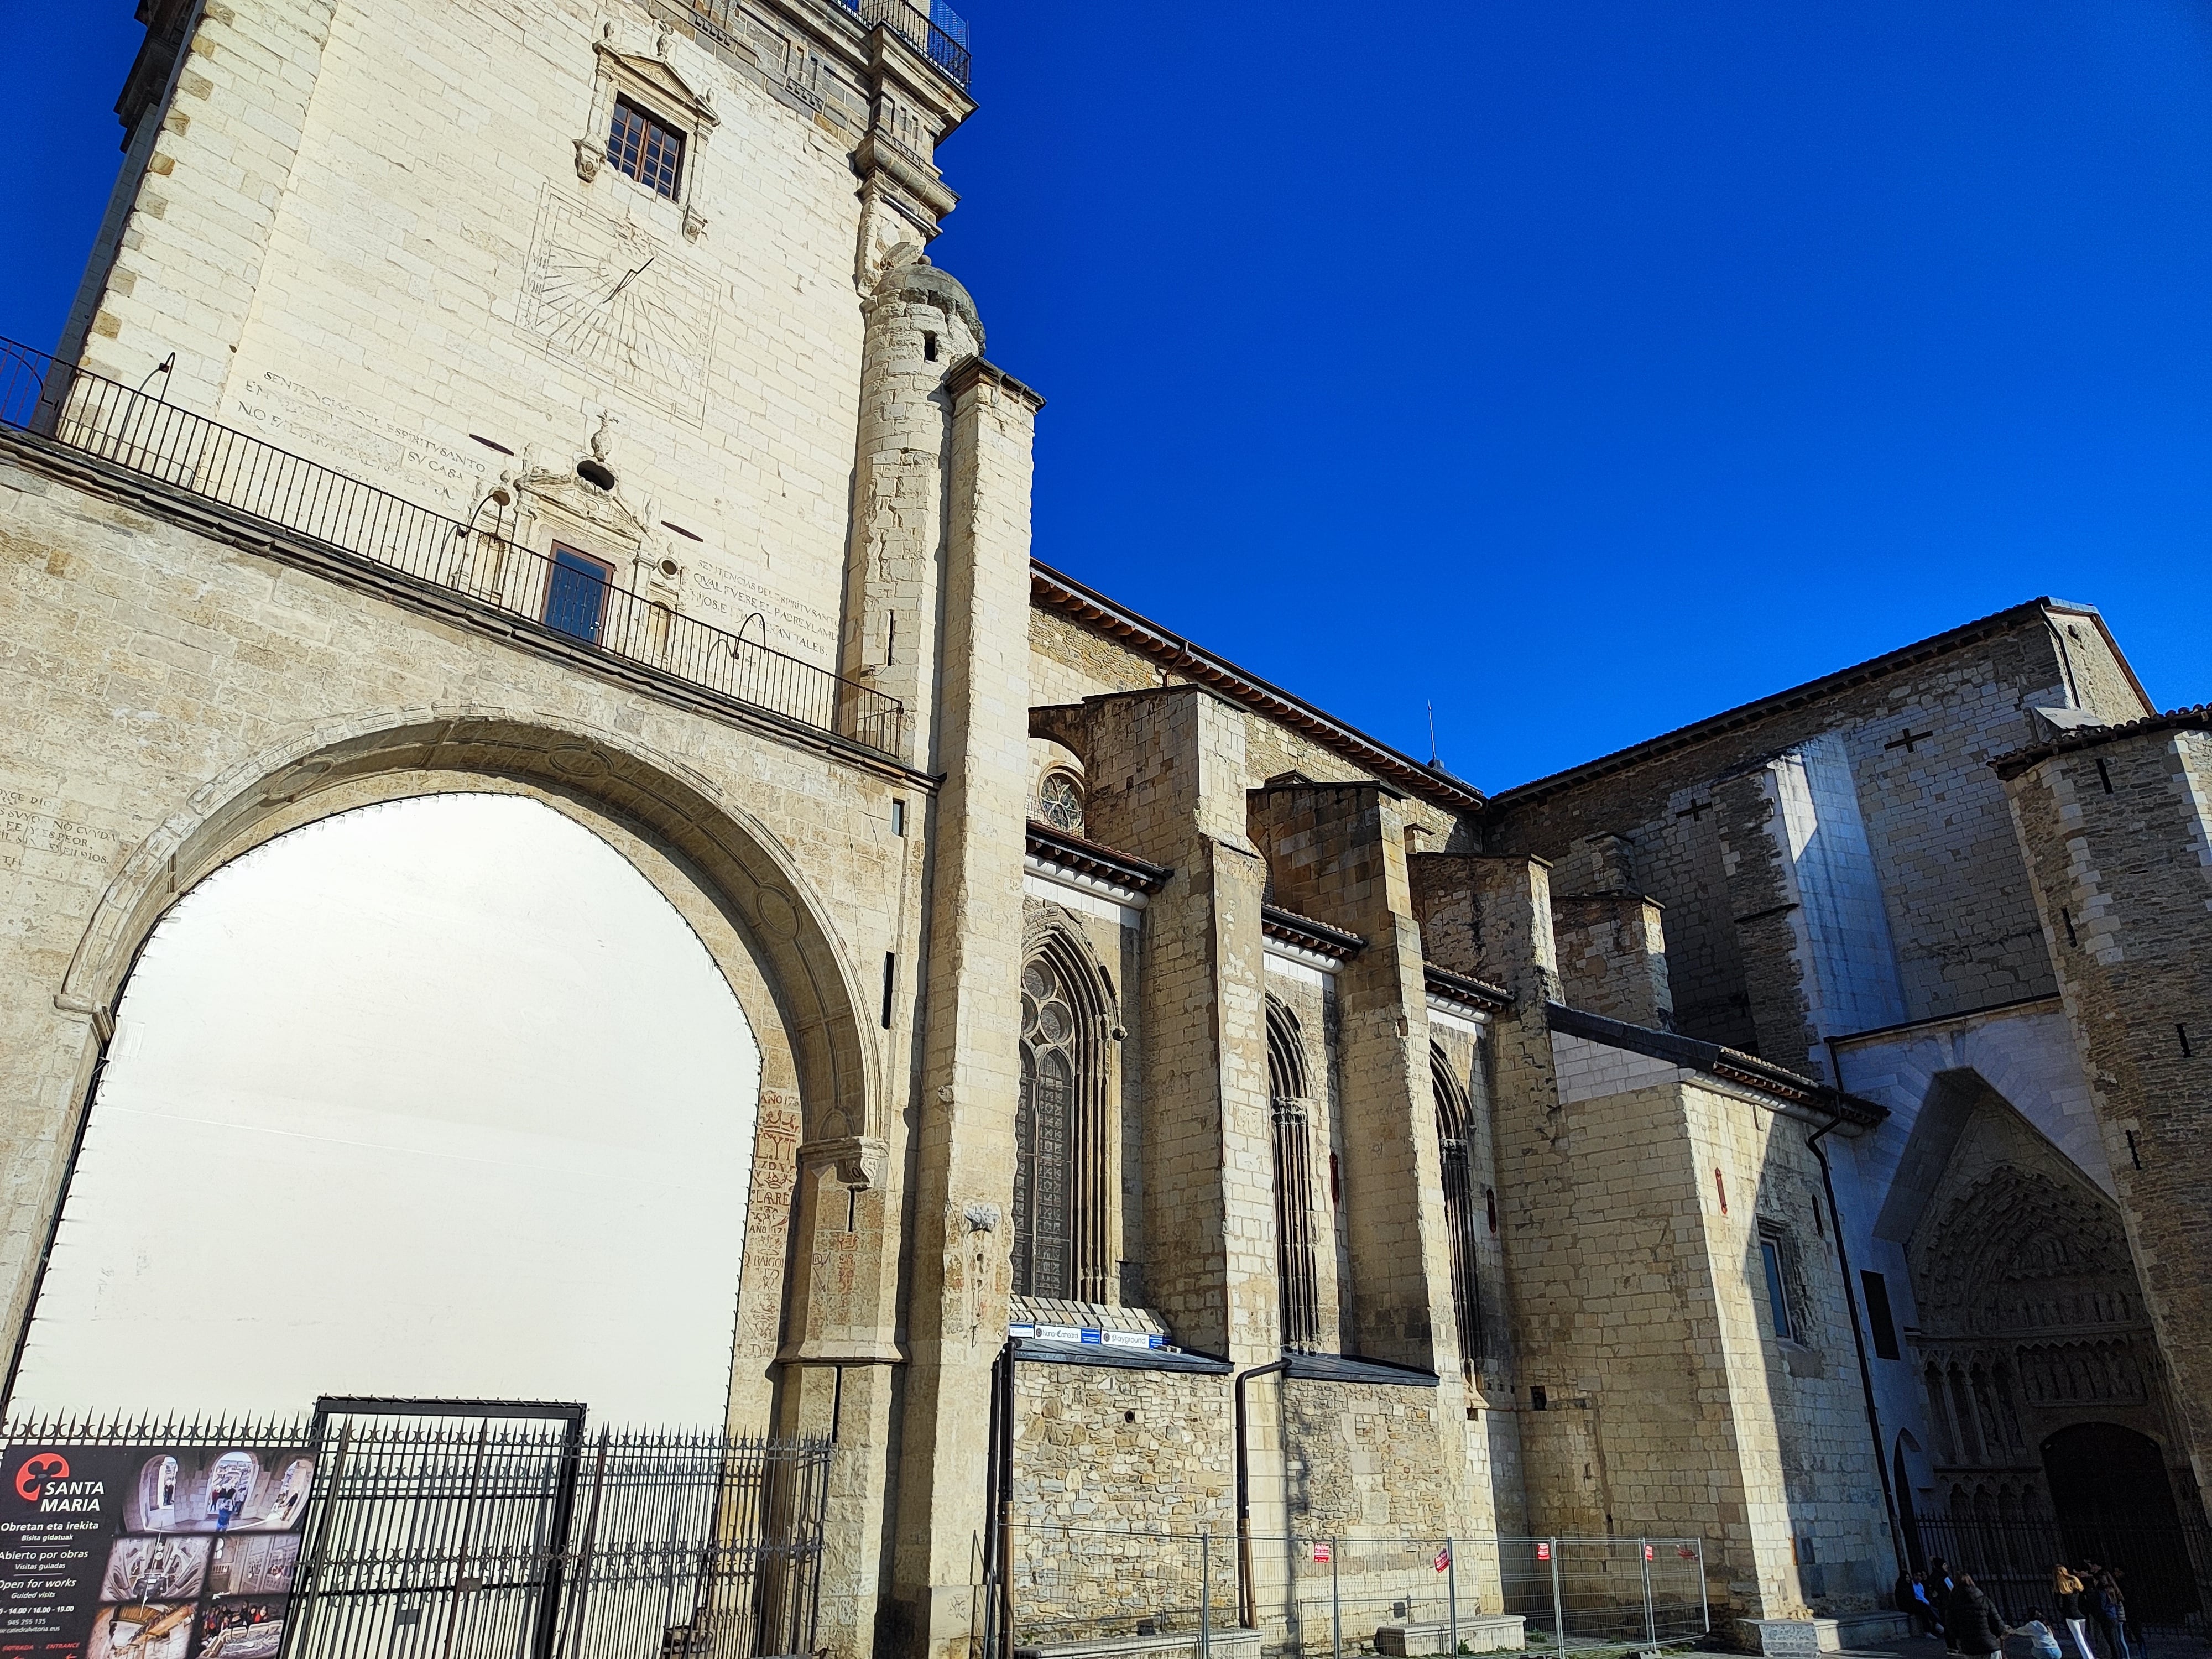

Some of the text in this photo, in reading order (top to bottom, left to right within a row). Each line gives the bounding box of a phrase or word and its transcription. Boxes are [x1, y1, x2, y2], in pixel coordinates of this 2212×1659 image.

[238, 400, 267, 420] NO
[697, 559, 756, 591] SENTENCIAS
[758, 585, 773, 598] DEL
[693, 573, 722, 592] QVAL
[724, 585, 758, 608] FVERE
[759, 601, 773, 614] EL
[53, 820, 73, 831] NO
[45, 1481, 105, 1495] SANTA
[40, 1498, 100, 1512] MARIA
[1, 1522, 44, 1531] Obretan
[66, 1521, 98, 1530] irekita
[0, 1550, 88, 1561] Abierto por obras
[0, 1578, 77, 1590] Open for works
